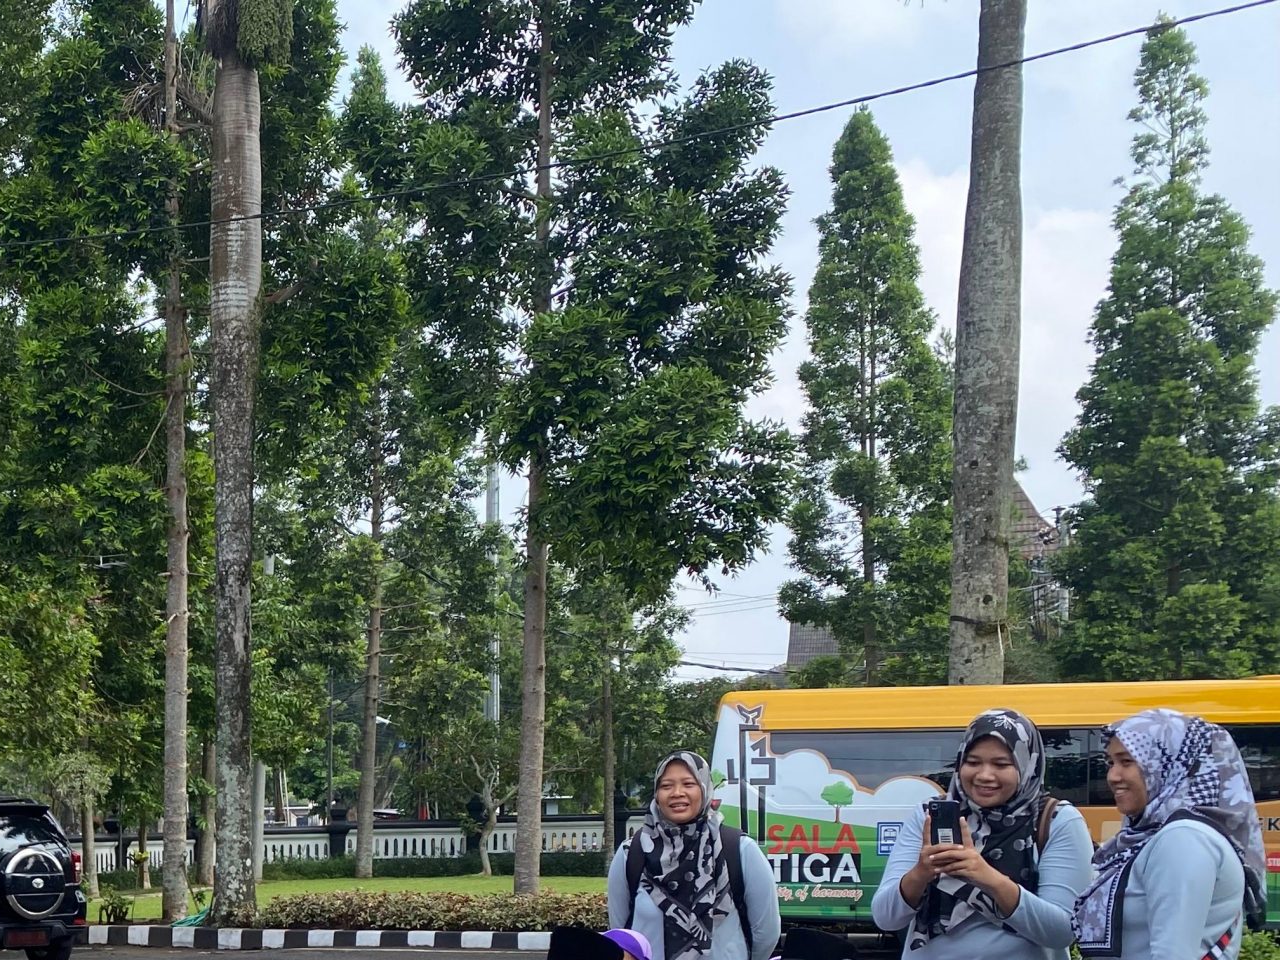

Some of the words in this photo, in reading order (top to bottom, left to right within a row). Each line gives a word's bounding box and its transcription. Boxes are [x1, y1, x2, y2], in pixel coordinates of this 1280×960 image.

[767, 824, 860, 853] SALA
[767, 853, 862, 883] TIGA
[776, 884, 795, 901] ity
[794, 885, 809, 902] of
[811, 883, 863, 901] harmony
